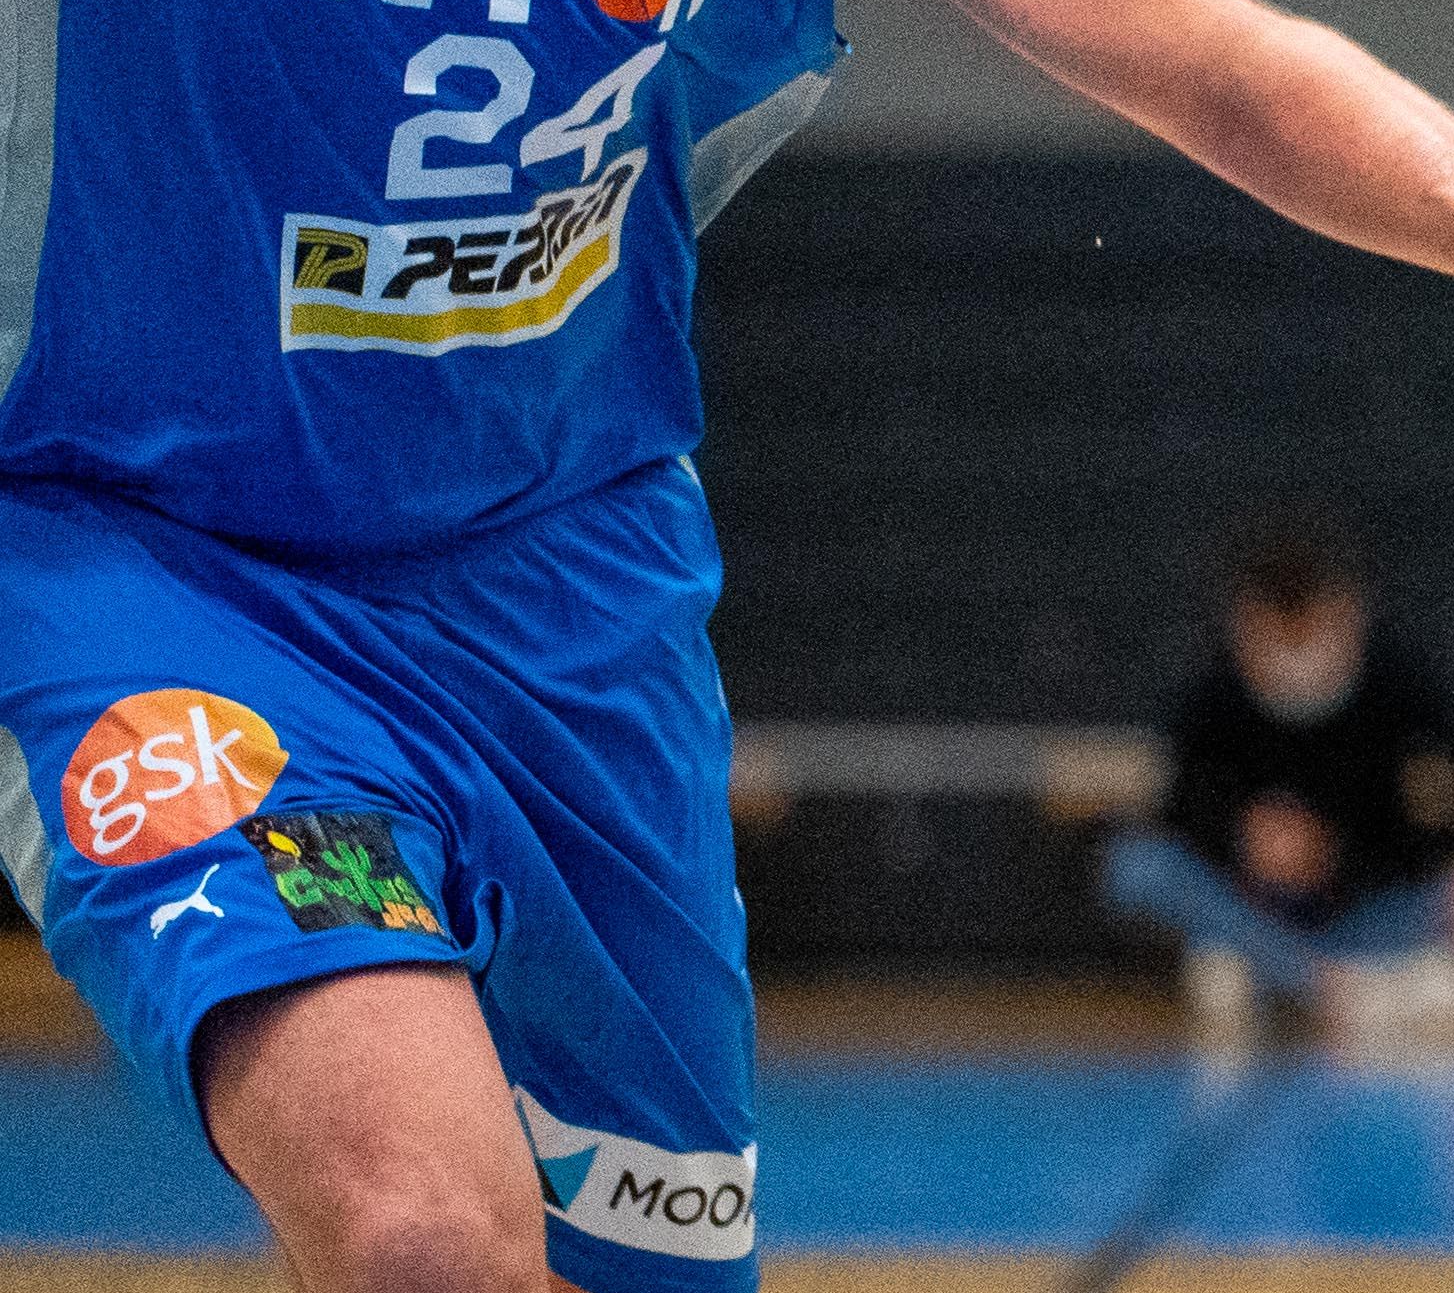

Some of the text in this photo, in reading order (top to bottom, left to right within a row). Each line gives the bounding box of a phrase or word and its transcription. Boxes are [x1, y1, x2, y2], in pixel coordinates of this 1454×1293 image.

[385, 33, 666, 200] 24
[78, 705, 260, 856] gsk
[609, 1168, 753, 1229] MOO
